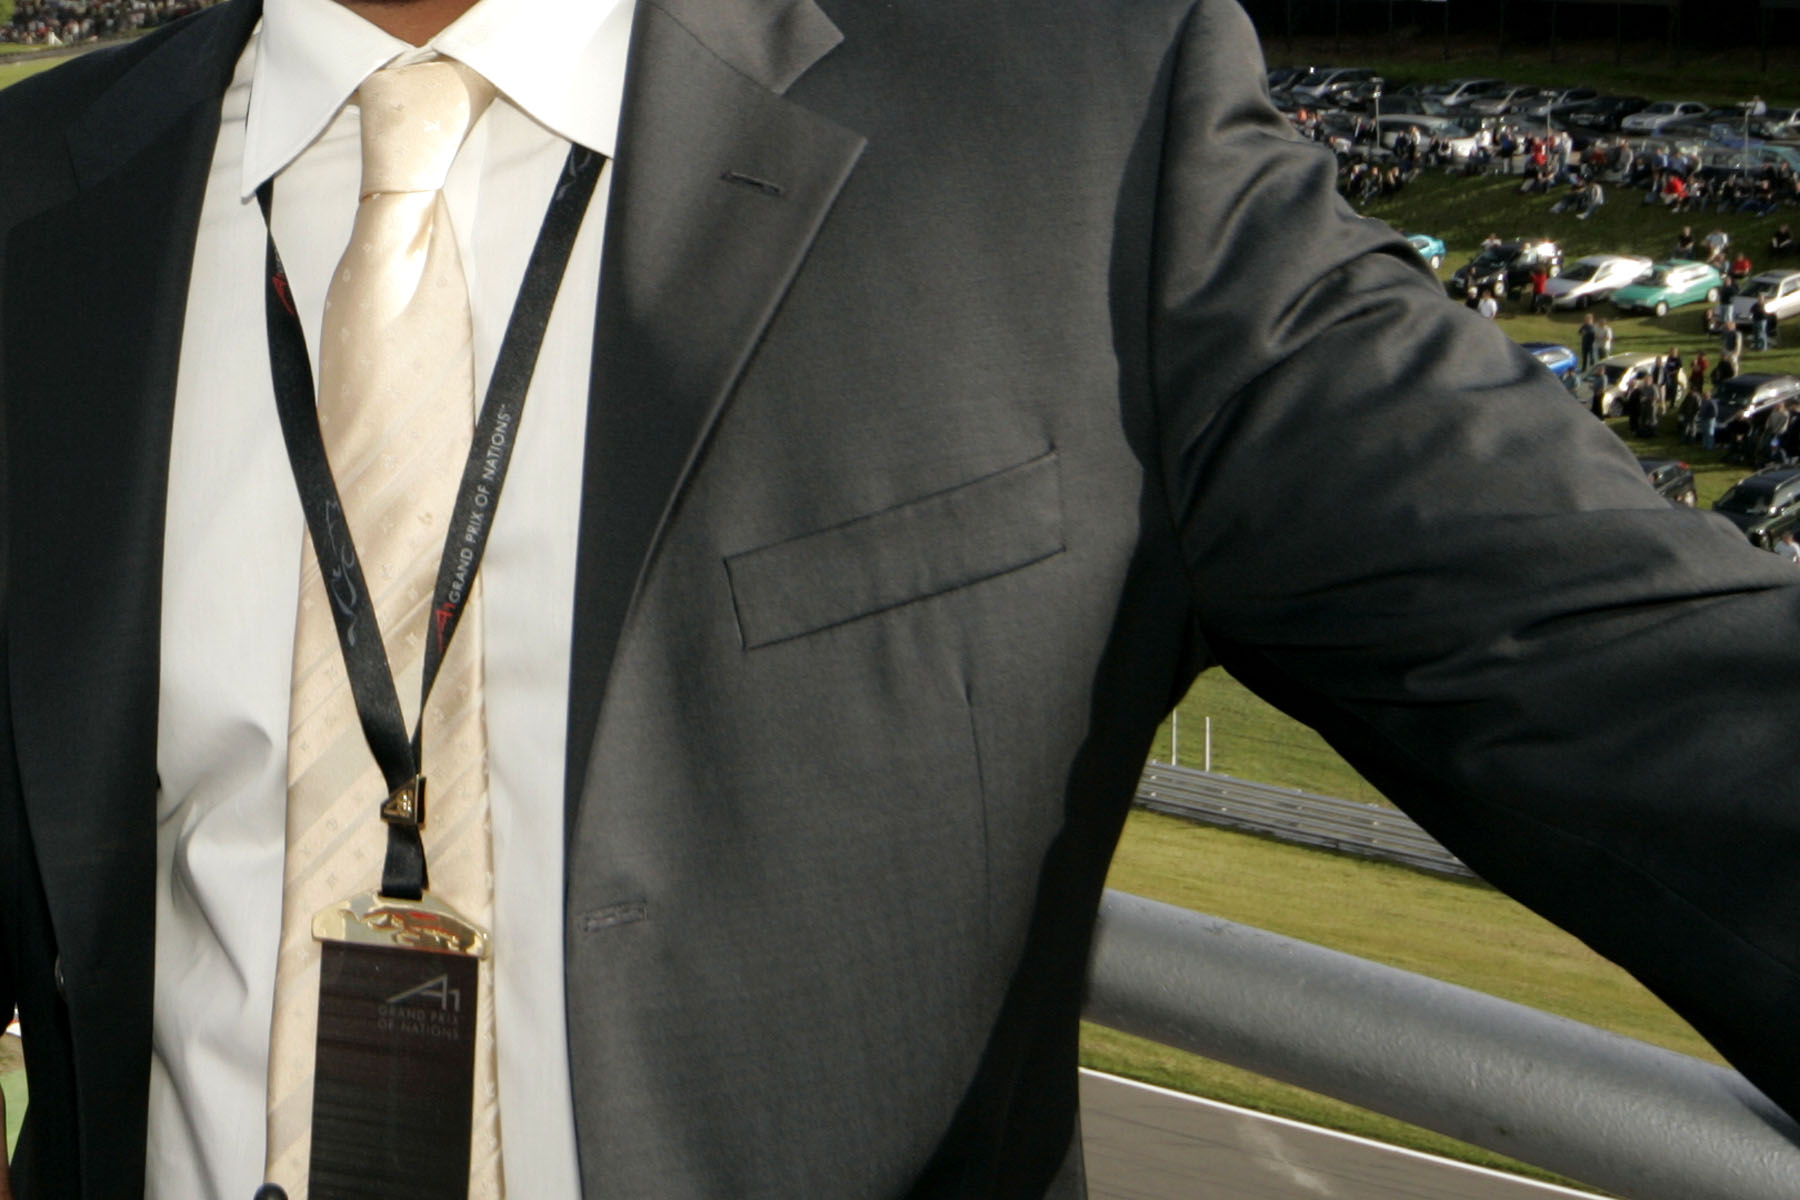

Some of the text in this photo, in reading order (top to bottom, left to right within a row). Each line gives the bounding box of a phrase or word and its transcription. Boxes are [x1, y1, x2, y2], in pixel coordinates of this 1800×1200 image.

[474, 485, 491, 508] OF
[465, 511, 484, 544] PRIX
[448, 547, 474, 603] GRAND
[378, 1005, 460, 1024] GRAND PRIX
[377, 1018, 460, 1040] OF NATIONS
